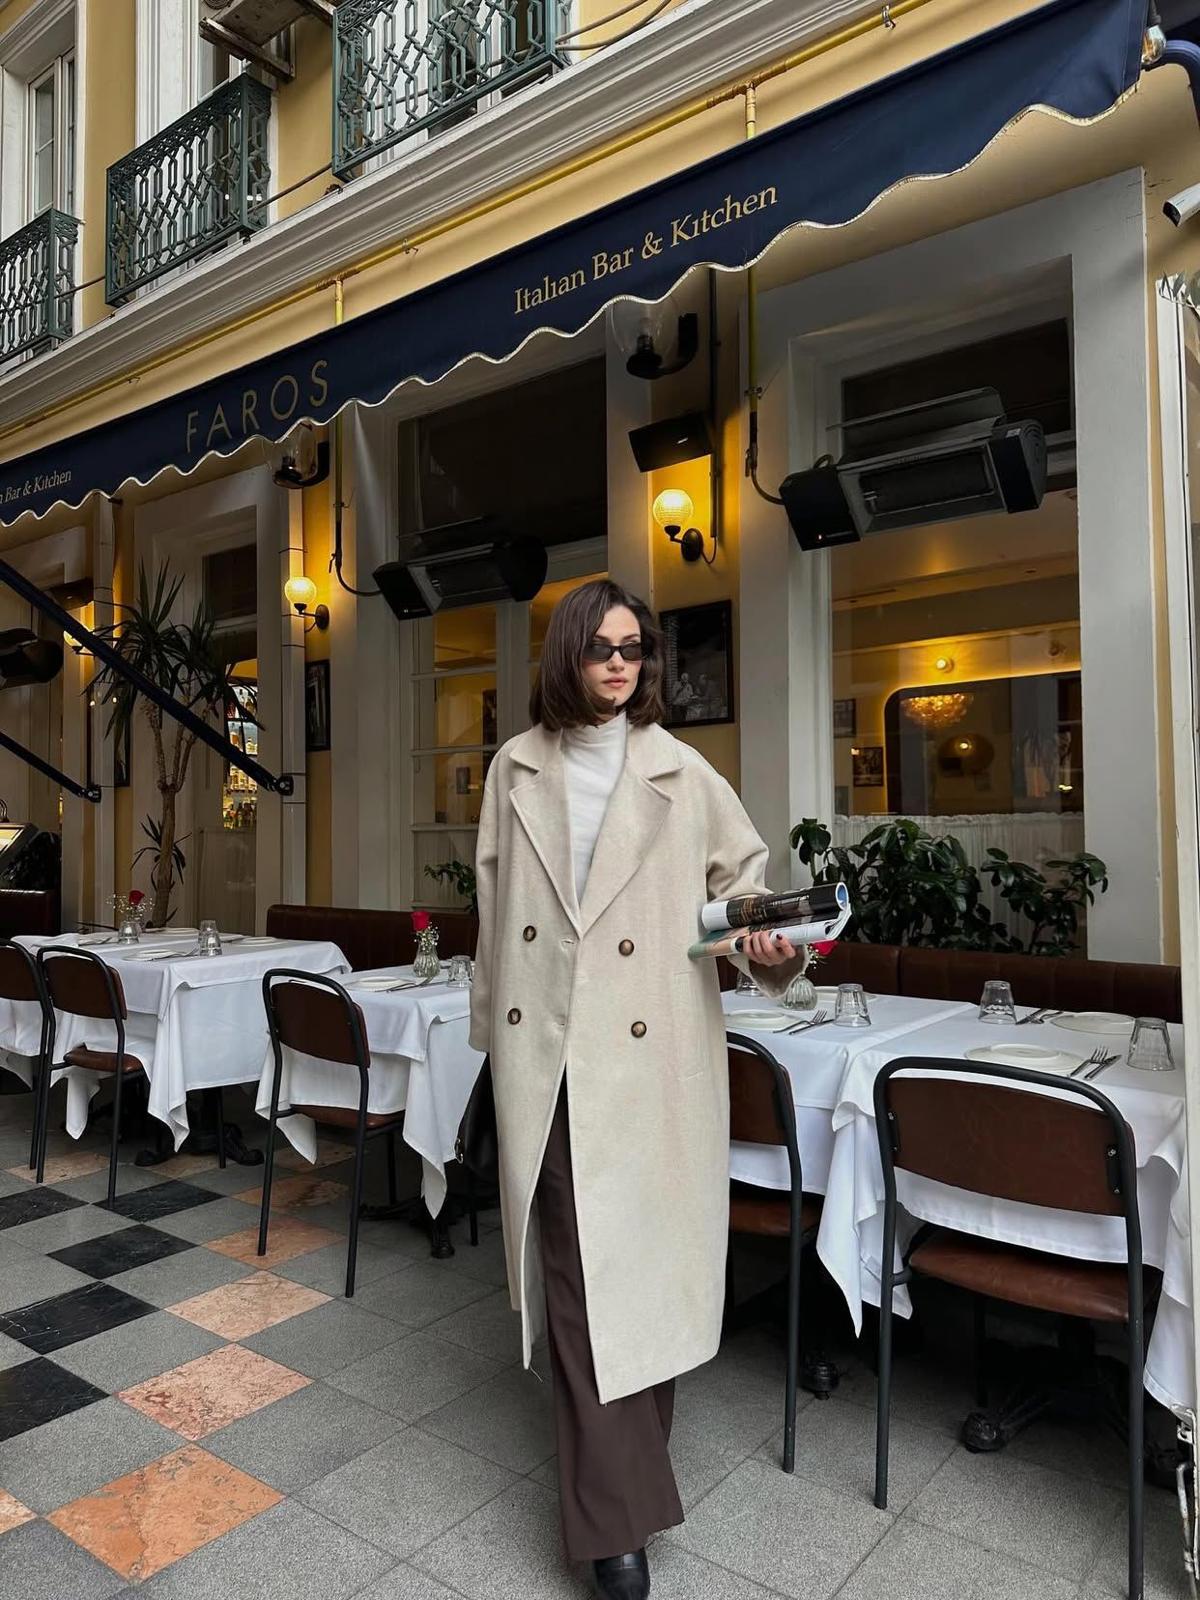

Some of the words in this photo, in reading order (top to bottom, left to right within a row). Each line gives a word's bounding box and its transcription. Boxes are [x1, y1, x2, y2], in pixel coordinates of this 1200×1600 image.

[592, 247, 634, 280] Bar
[641, 231, 664, 259] &
[186, 360, 328, 453] FAROS
[5, 486, 22, 502] Bar
[22, 480, 32, 496] &
